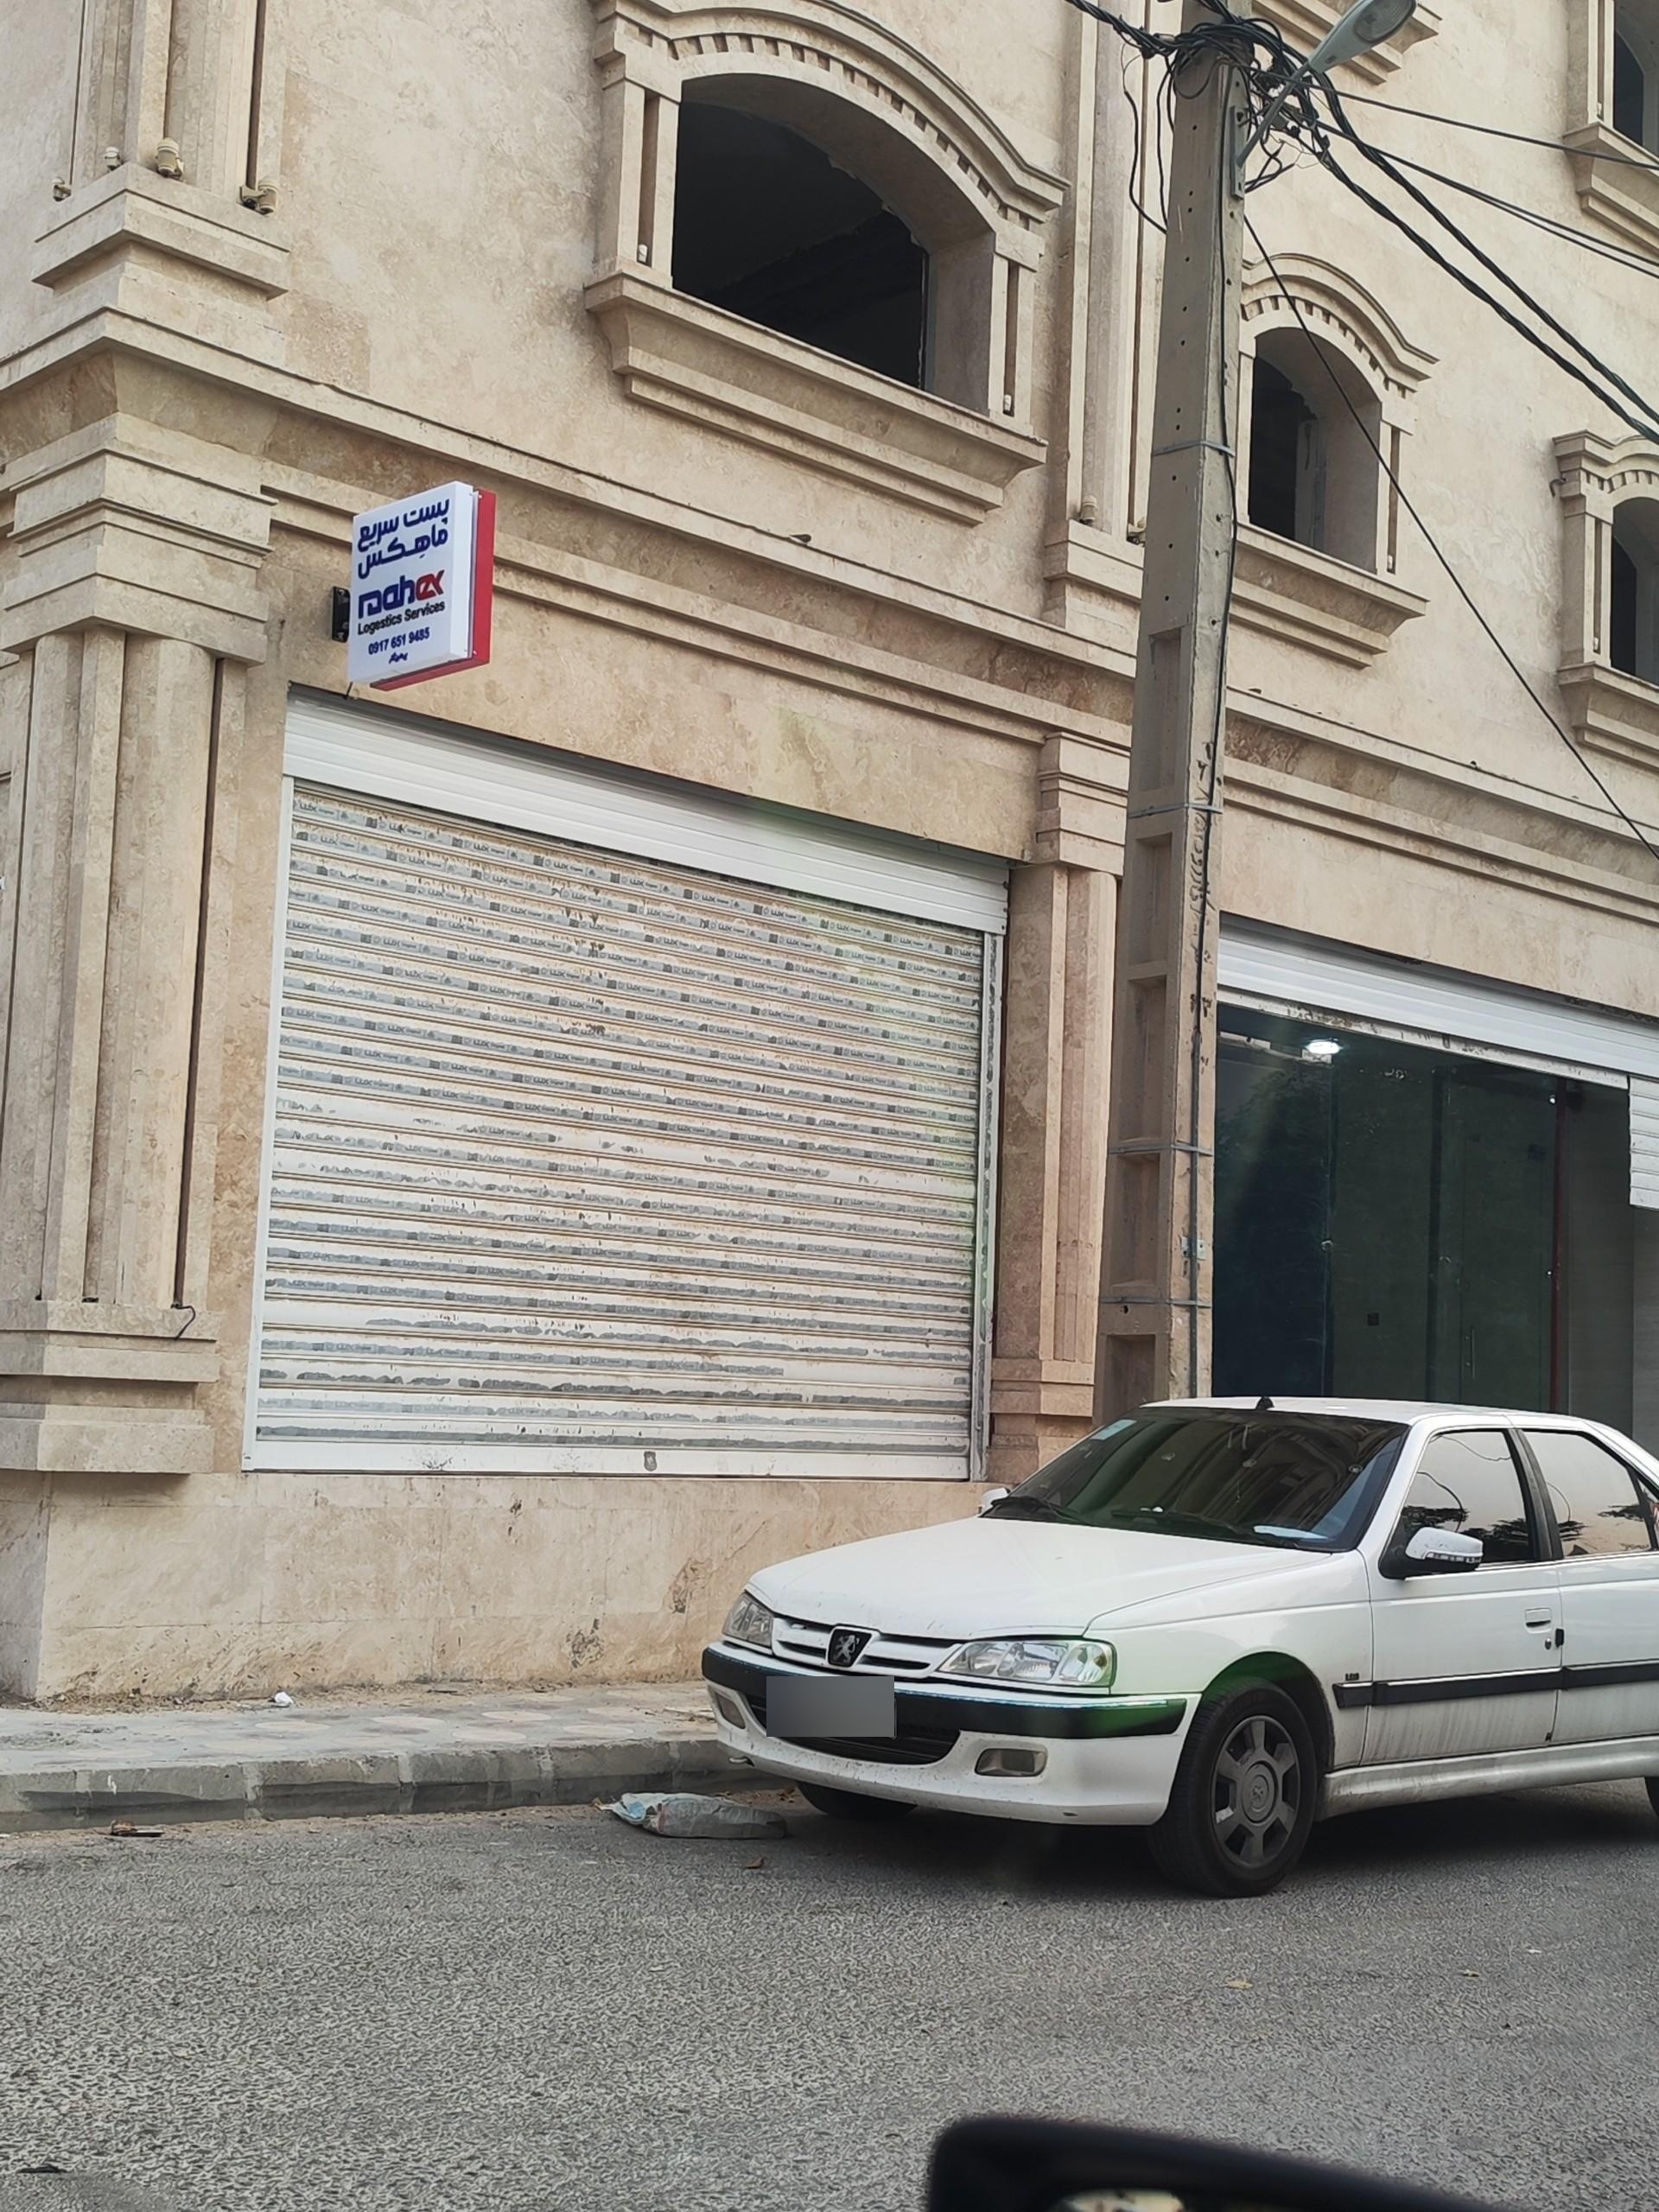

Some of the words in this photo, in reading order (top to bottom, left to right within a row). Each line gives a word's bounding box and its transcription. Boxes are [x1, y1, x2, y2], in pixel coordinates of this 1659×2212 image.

[404, 499, 449, 525] پست
[358, 516, 399, 552] سریع
[404, 601, 445, 621] Services
[368, 639, 390, 655] 0917
[391, 633, 406, 649] 651
